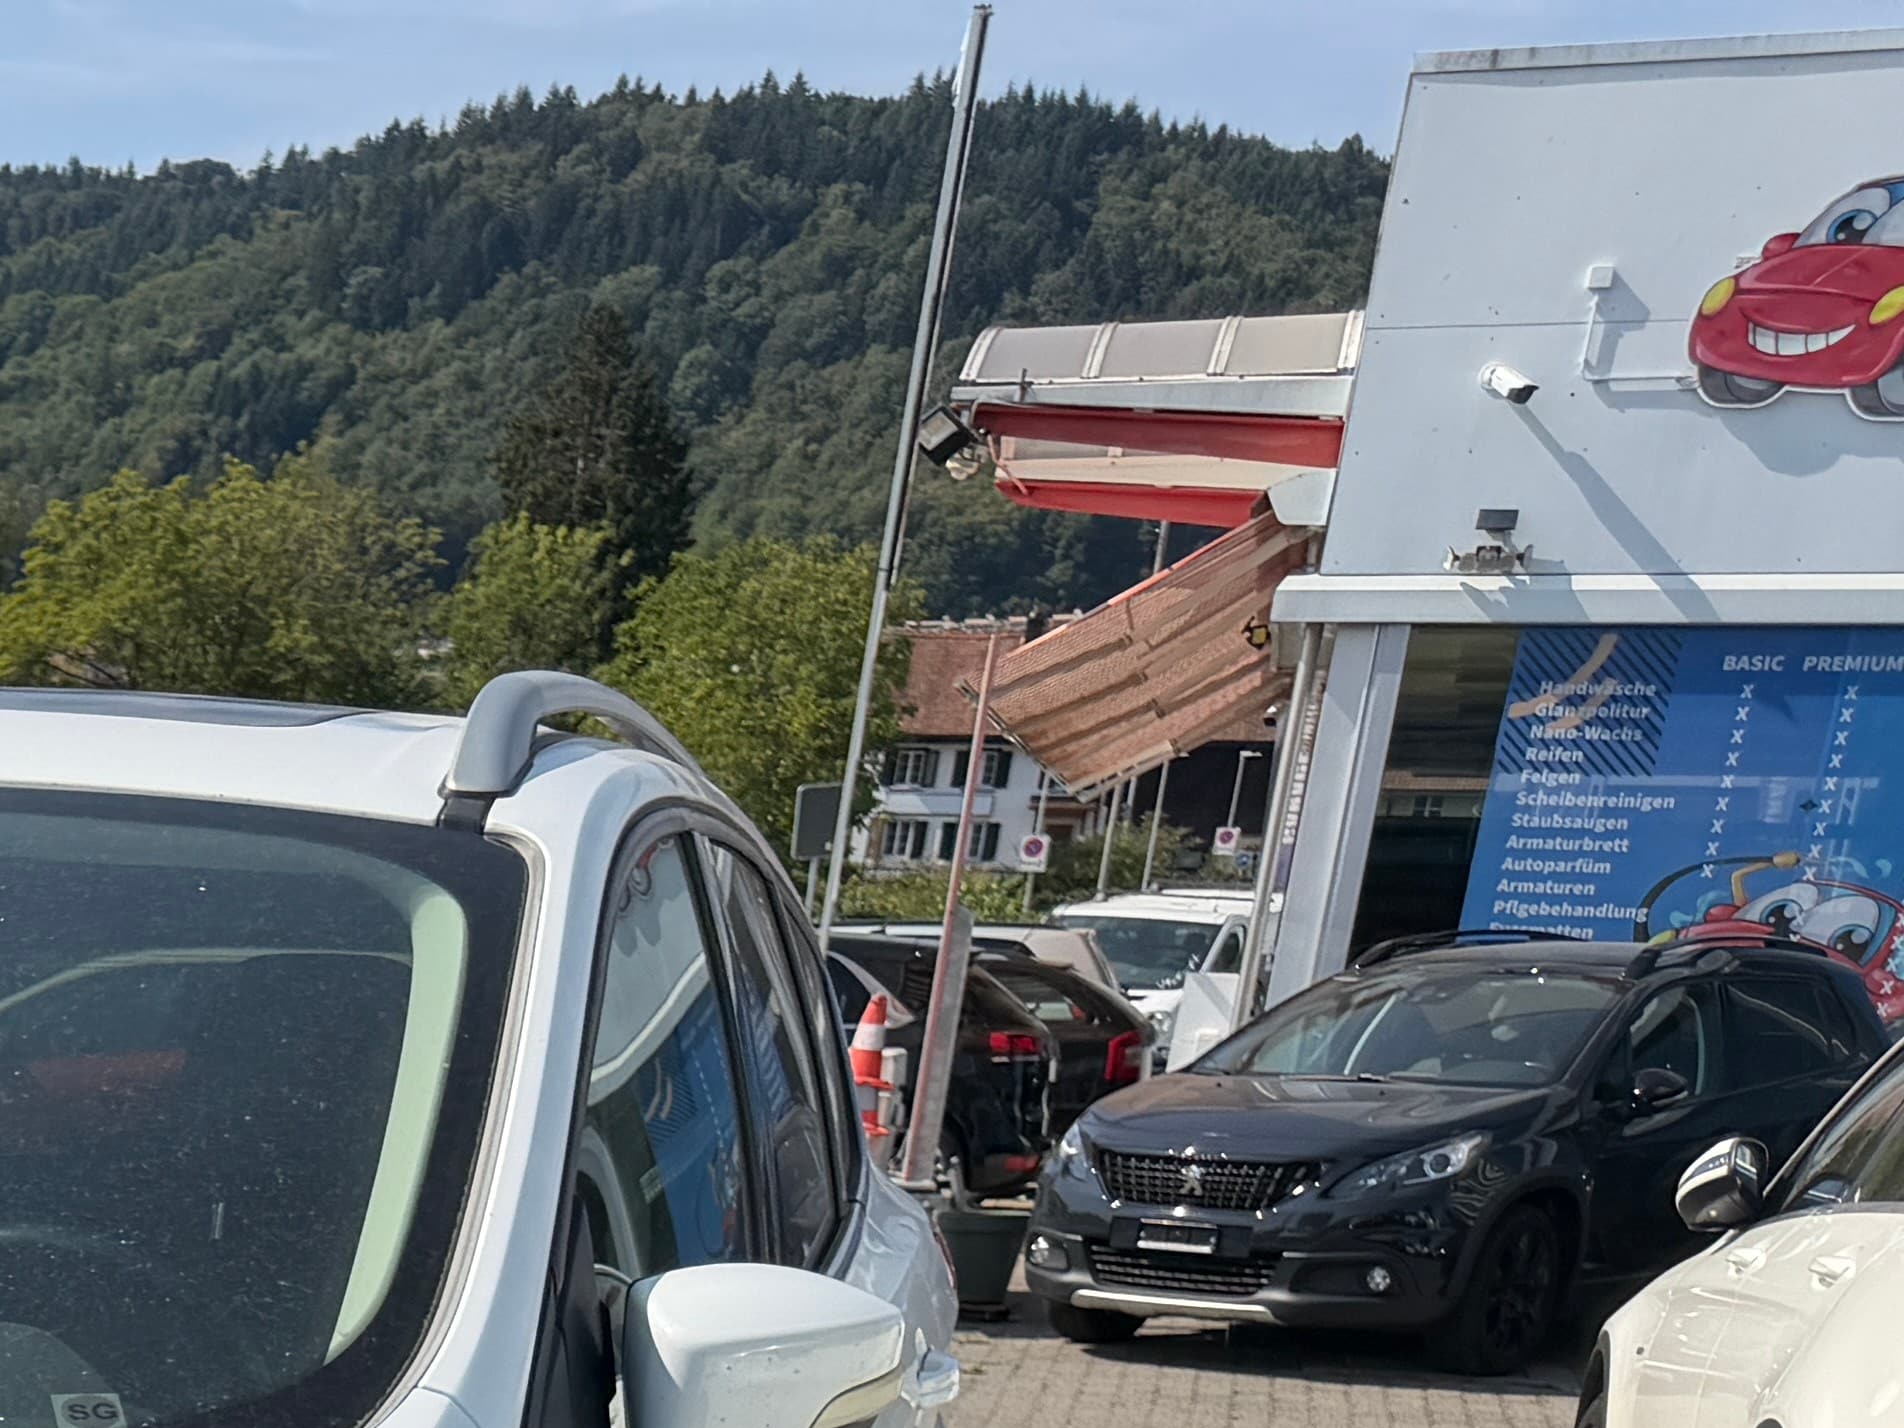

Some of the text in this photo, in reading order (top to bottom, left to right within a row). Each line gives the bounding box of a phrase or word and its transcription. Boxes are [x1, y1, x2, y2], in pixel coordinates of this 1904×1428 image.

[1722, 655, 1904, 673] BASIC PREMIUM
[1538, 680, 1657, 697] Handwäsche
[1529, 725, 1642, 743] Nano-Wachs
[1525, 747, 1584, 763] Reifen
[1520, 769, 1582, 787] Felgen
[1515, 790, 1675, 813] Scheibenreinigen
[1511, 812, 1629, 833] Staubsaugen
[1505, 834, 1630, 854] Armaturbrett
[1501, 856, 1612, 875] Autoparfüm
[1496, 878, 1596, 896] Armaturen
[68, 1402, 118, 1420] SG
